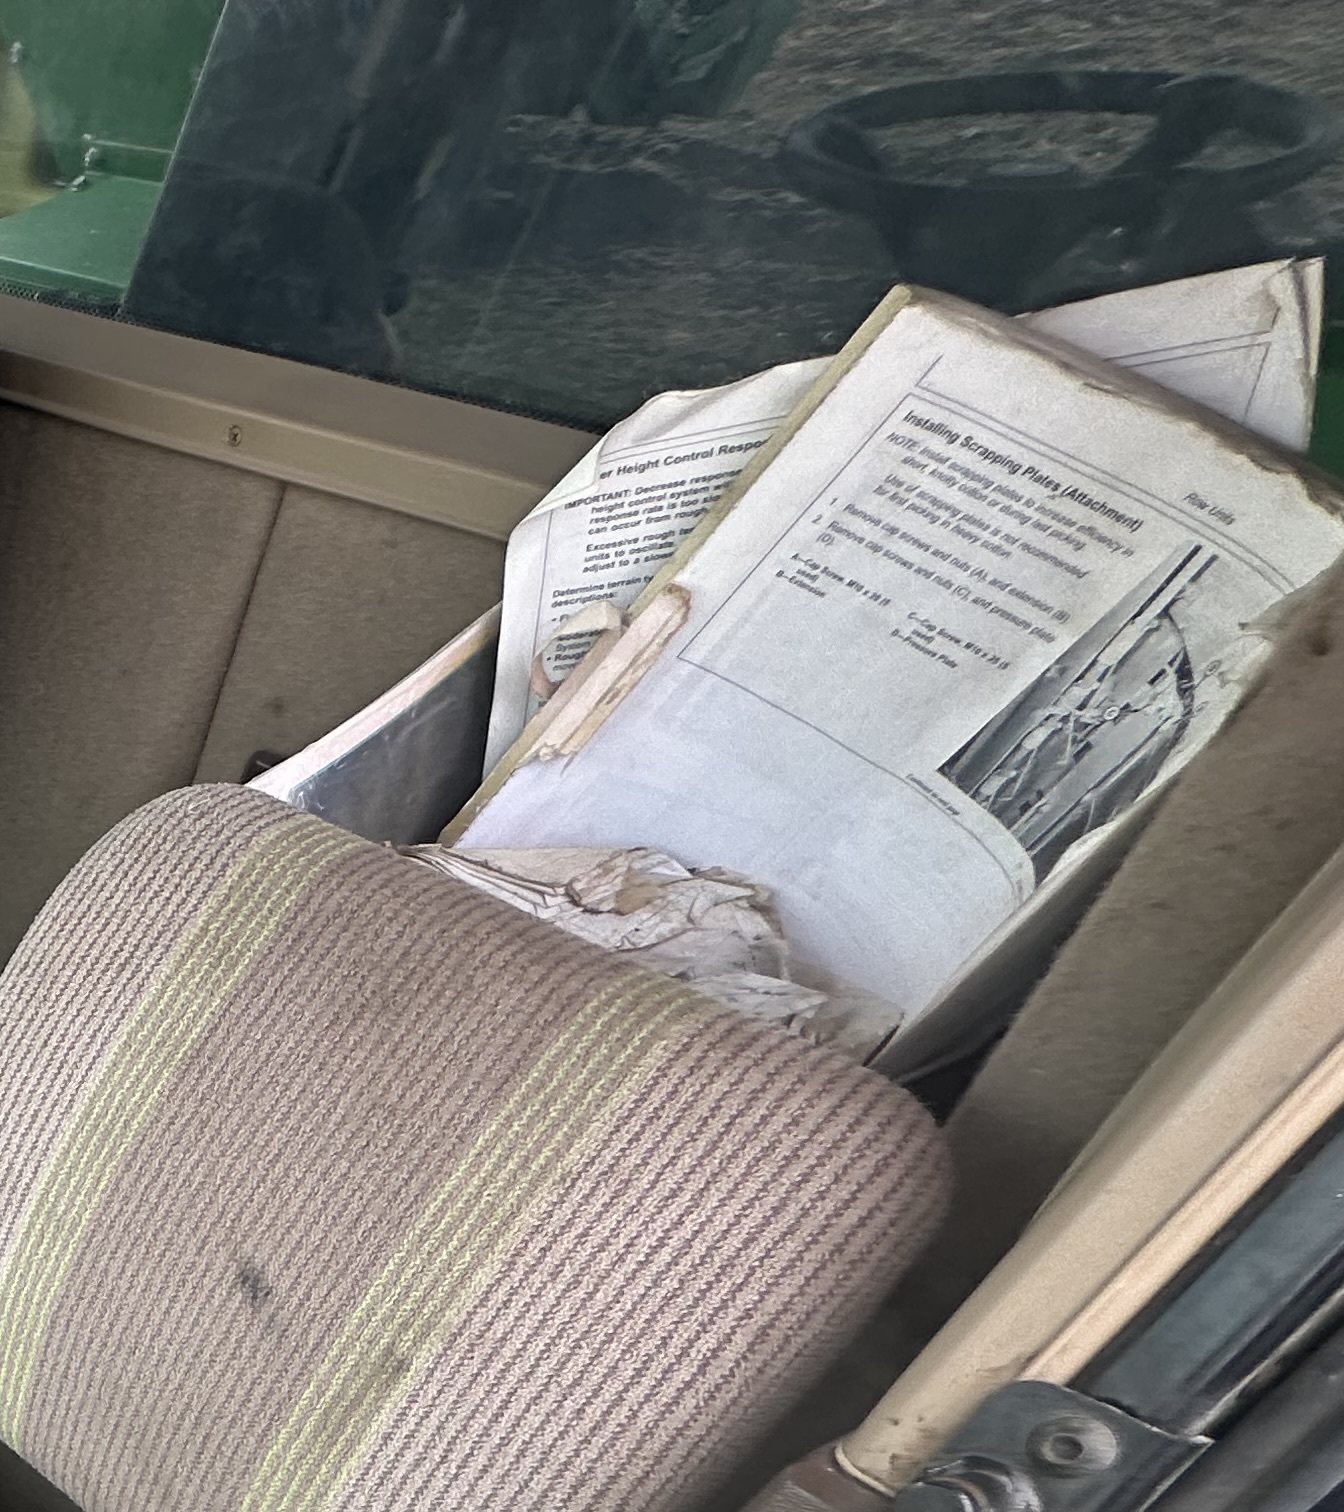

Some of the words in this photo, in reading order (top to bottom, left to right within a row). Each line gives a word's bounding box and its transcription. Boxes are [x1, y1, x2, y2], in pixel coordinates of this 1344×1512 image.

[616, 457, 658, 478] Height
[663, 445, 713, 468] Control
[901, 408, 962, 445] Installing
[955, 434, 1024, 476] Scrapping
[1021, 464, 1064, 491] Plates
[1057, 483, 1144, 533] (Attachment)
[635, 476, 685, 497] Decrease
[591, 500, 624, 515] height
[627, 492, 666, 507] control
[669, 485, 709, 500] system
[589, 509, 639, 526] response
[642, 504, 662, 515] rate
[666, 501, 677, 509] is
[680, 497, 698, 507] too
[588, 525, 606, 535] can
[611, 518, 642, 530] occur
[645, 513, 670, 524] from
[586, 536, 639, 552] Excessive
[643, 529, 675, 542] rough
[582, 560, 615, 574] adjust
[618, 558, 629, 566] to
[584, 552, 609, 562] units
[614, 549, 624, 557] to
[553, 582, 604, 597] Determine
[607, 577, 641, 588] terrain
